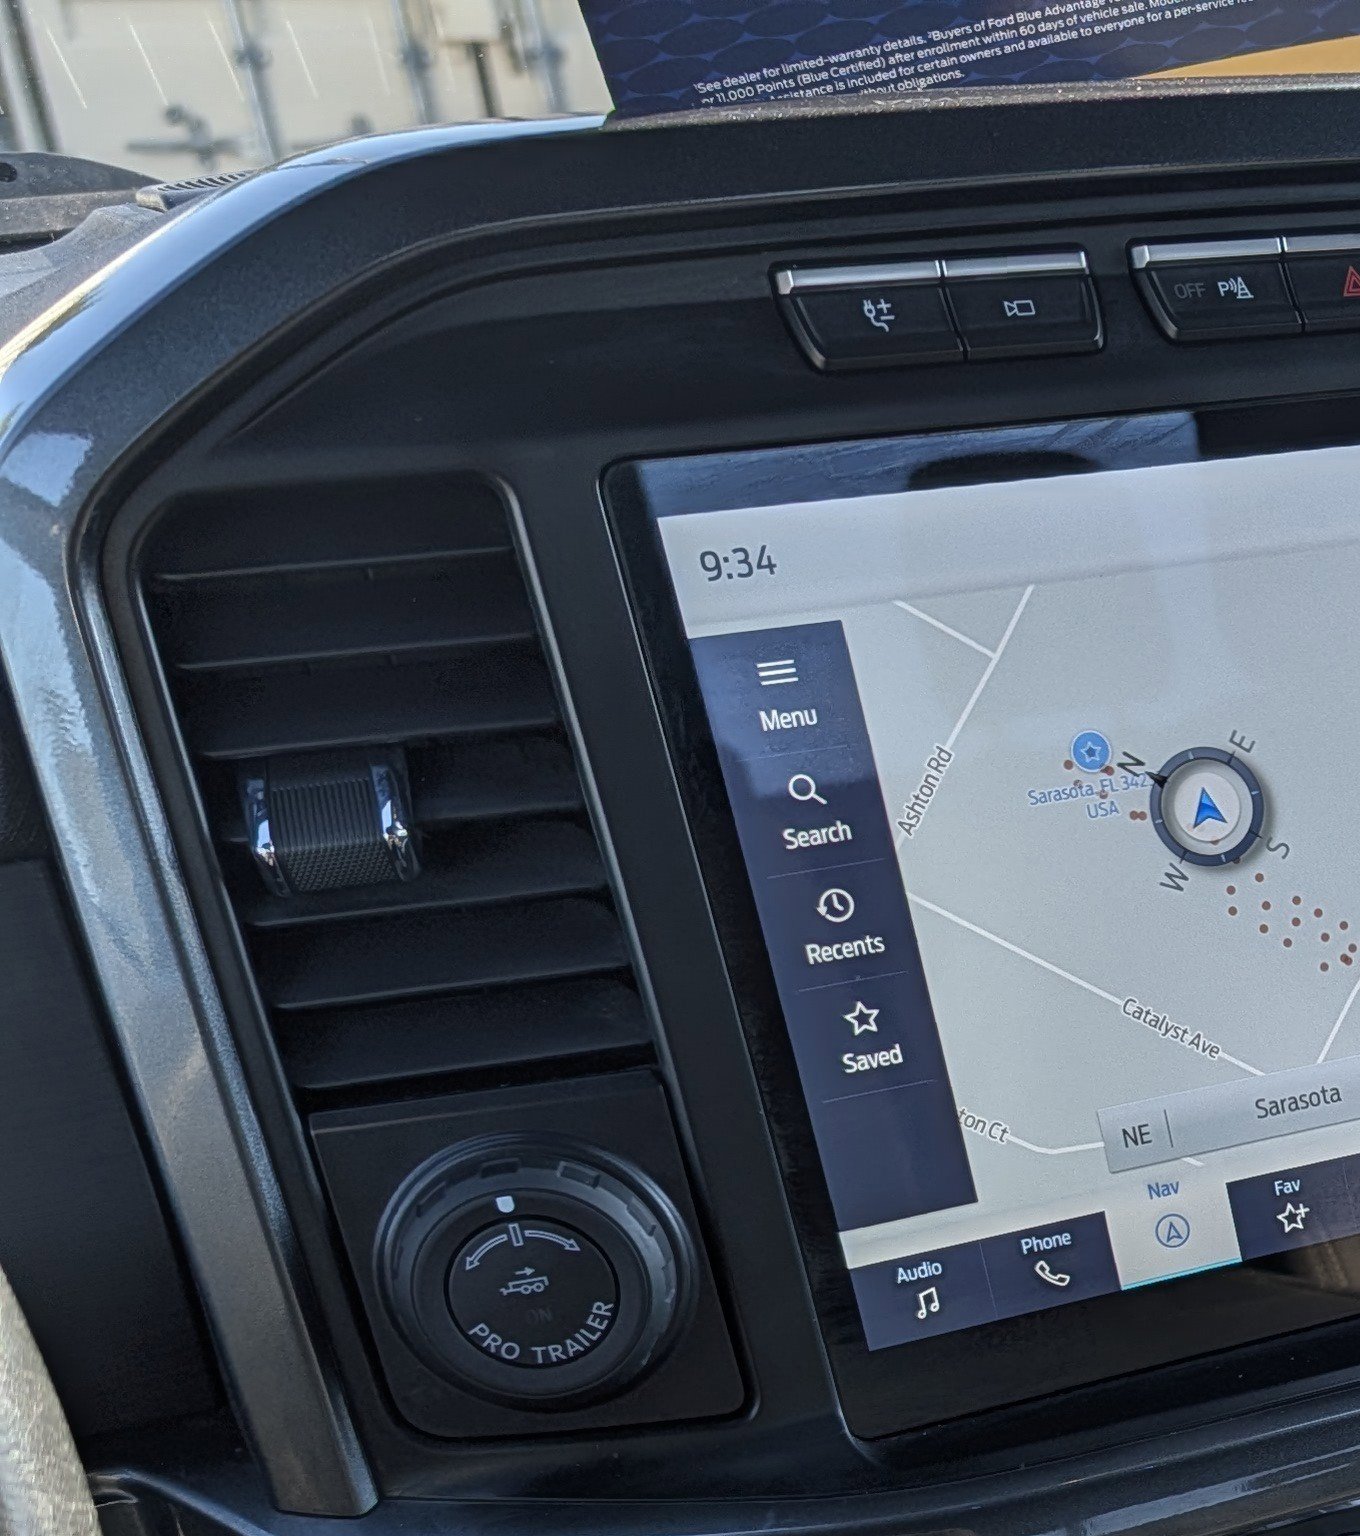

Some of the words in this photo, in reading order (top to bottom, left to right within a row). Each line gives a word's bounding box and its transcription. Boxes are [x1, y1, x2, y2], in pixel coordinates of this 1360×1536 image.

[723, 71, 761, 88] dealer
[763, 65, 780, 80] for
[782, 44, 881, 74] limited-warranty
[883, 35, 927, 52] details.
[973, 20, 986, 32] of
[987, 14, 1015, 29] Ford
[1016, 9, 1042, 23] Blue
[756, 77, 795, 94] Points
[797, 70, 829, 86] (Blue
[830, 56, 886, 79] Certified)
[888, 50, 915, 66] after
[917, 37, 981, 59] enrollment
[982, 27, 1018, 45] within
[1019, 24, 1036, 37] 60
[1037, 18, 1065, 33] days
[1065, 13, 1078, 27] of
[1079, 7, 1120, 23] vehicle
[1121, 2, 1148, 15] sale.
[835, 80, 846, 92] is
[847, 70, 896, 89] included
[898, 65, 915, 79] for
[917, 57, 958, 74] certain
[960, 48, 1001, 65] owners
[1003, 39, 1026, 55] and
[1026, 30, 1079, 49] available
[1080, 26, 1092, 37] to
[1093, 16, 1145, 35] everyone
[1146, 10, 1163, 23] for
[1164, 11, 1172, 19] a
[897, 69, 965, 91] obligations.
[1174, 283, 1206, 299] OFF
[699, 544, 778, 582] 9:34
[758, 707, 818, 732] Menu
[1228, 729, 1256, 753] E
[1116, 751, 1146, 777] N
[898, 773, 940, 837] Ashton
[927, 745, 953, 774] Rd
[1099, 778, 1119, 793] FL
[1087, 800, 1120, 819] USA
[783, 819, 853, 850] Search
[1265, 836, 1290, 860] S
[1159, 862, 1189, 892] W
[805, 935, 885, 965] Recents
[1121, 998, 1190, 1045] Catalyst
[1188, 1032, 1221, 1060] Ave
[842, 1044, 904, 1074] Saved
[1254, 1085, 1343, 1120] Sarasota
[988, 1121, 1009, 1143] Ct
[1121, 1123, 1153, 1149] NE
[1147, 1179, 1180, 1200] Nav
[1274, 1178, 1301, 1197] Fav
[1020, 1229, 1072, 1257] Phone
[895, 1259, 943, 1285] Audio
[467, 1322, 521, 1361] PRO
[531, 1300, 615, 1364] TRAILER
